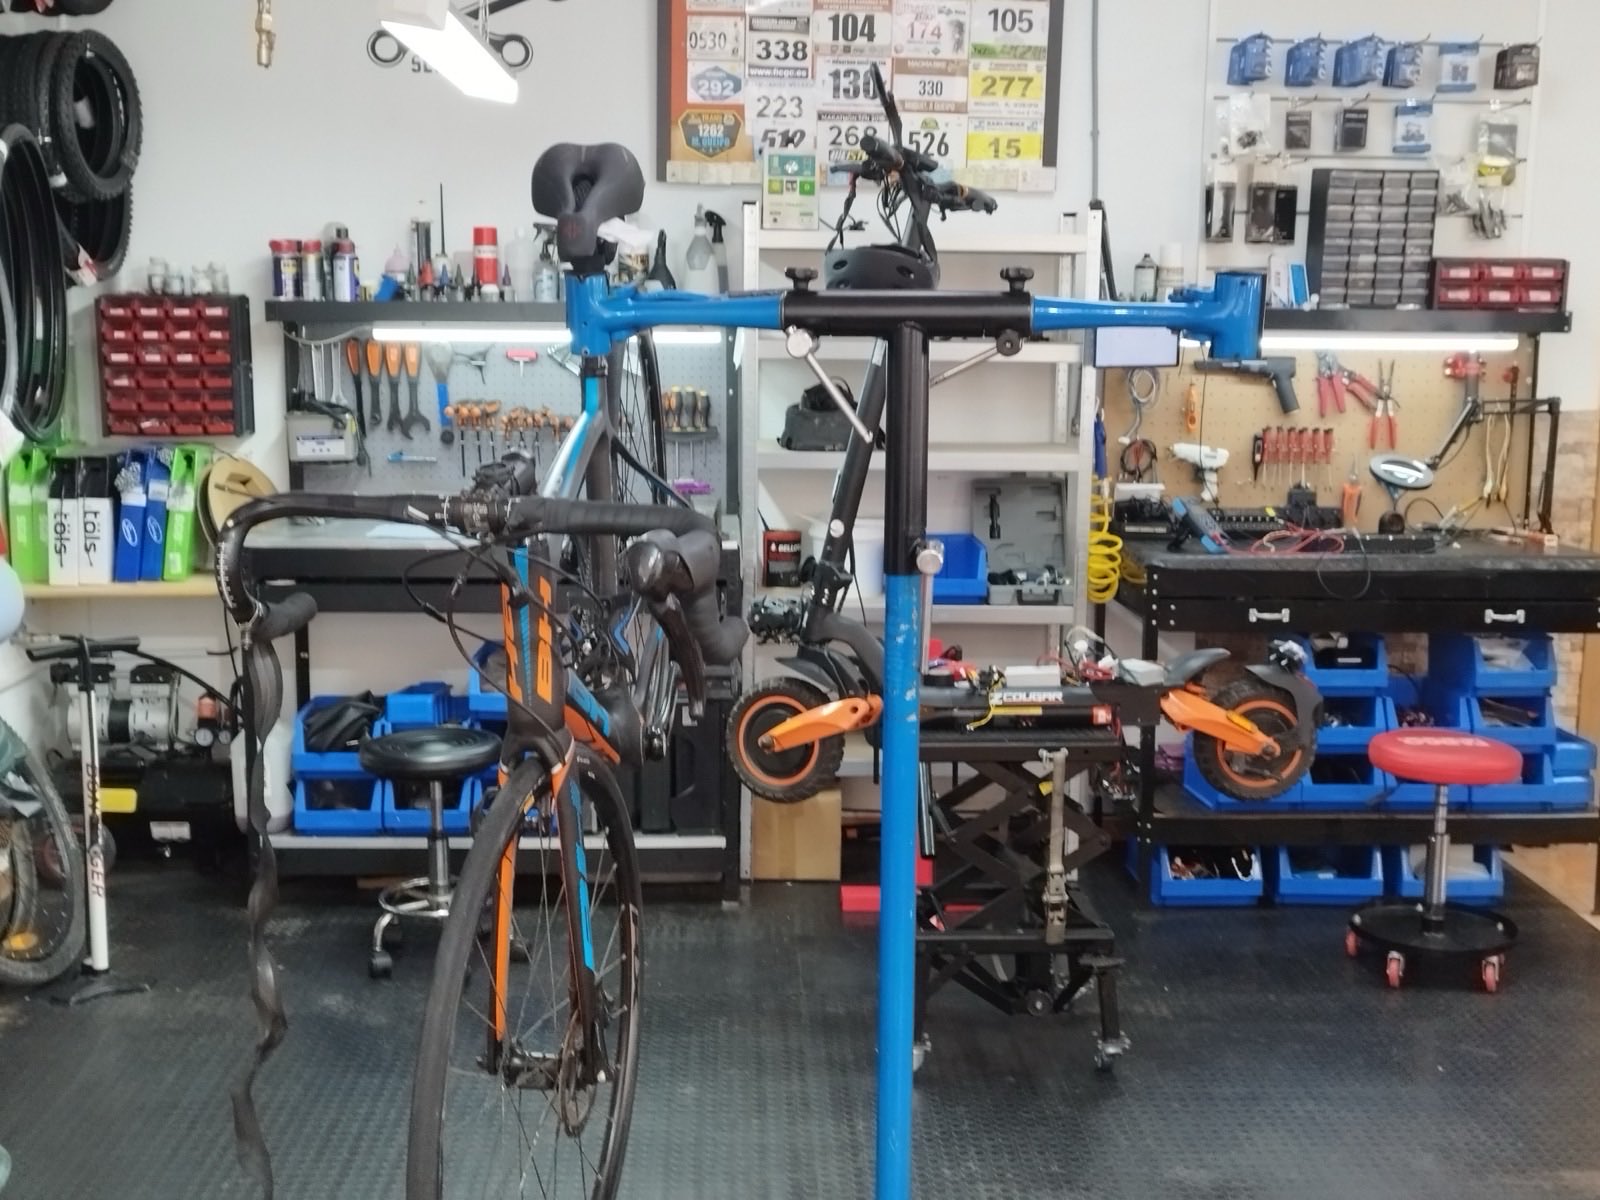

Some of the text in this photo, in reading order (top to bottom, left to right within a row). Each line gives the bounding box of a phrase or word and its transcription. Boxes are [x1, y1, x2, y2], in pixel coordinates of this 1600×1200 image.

[828, 13, 876, 43] 104
[909, 21, 943, 40] 174
[988, 8, 1034, 33] 105
[689, 31, 727, 50] 0530
[756, 39, 808, 61] 338
[697, 79, 735, 97] 292
[918, 80, 943, 97] 330
[981, 75, 1034, 98] 277
[756, 95, 803, 119] 223
[908, 131, 949, 158] 526
[988, 137, 1022, 159] 15
